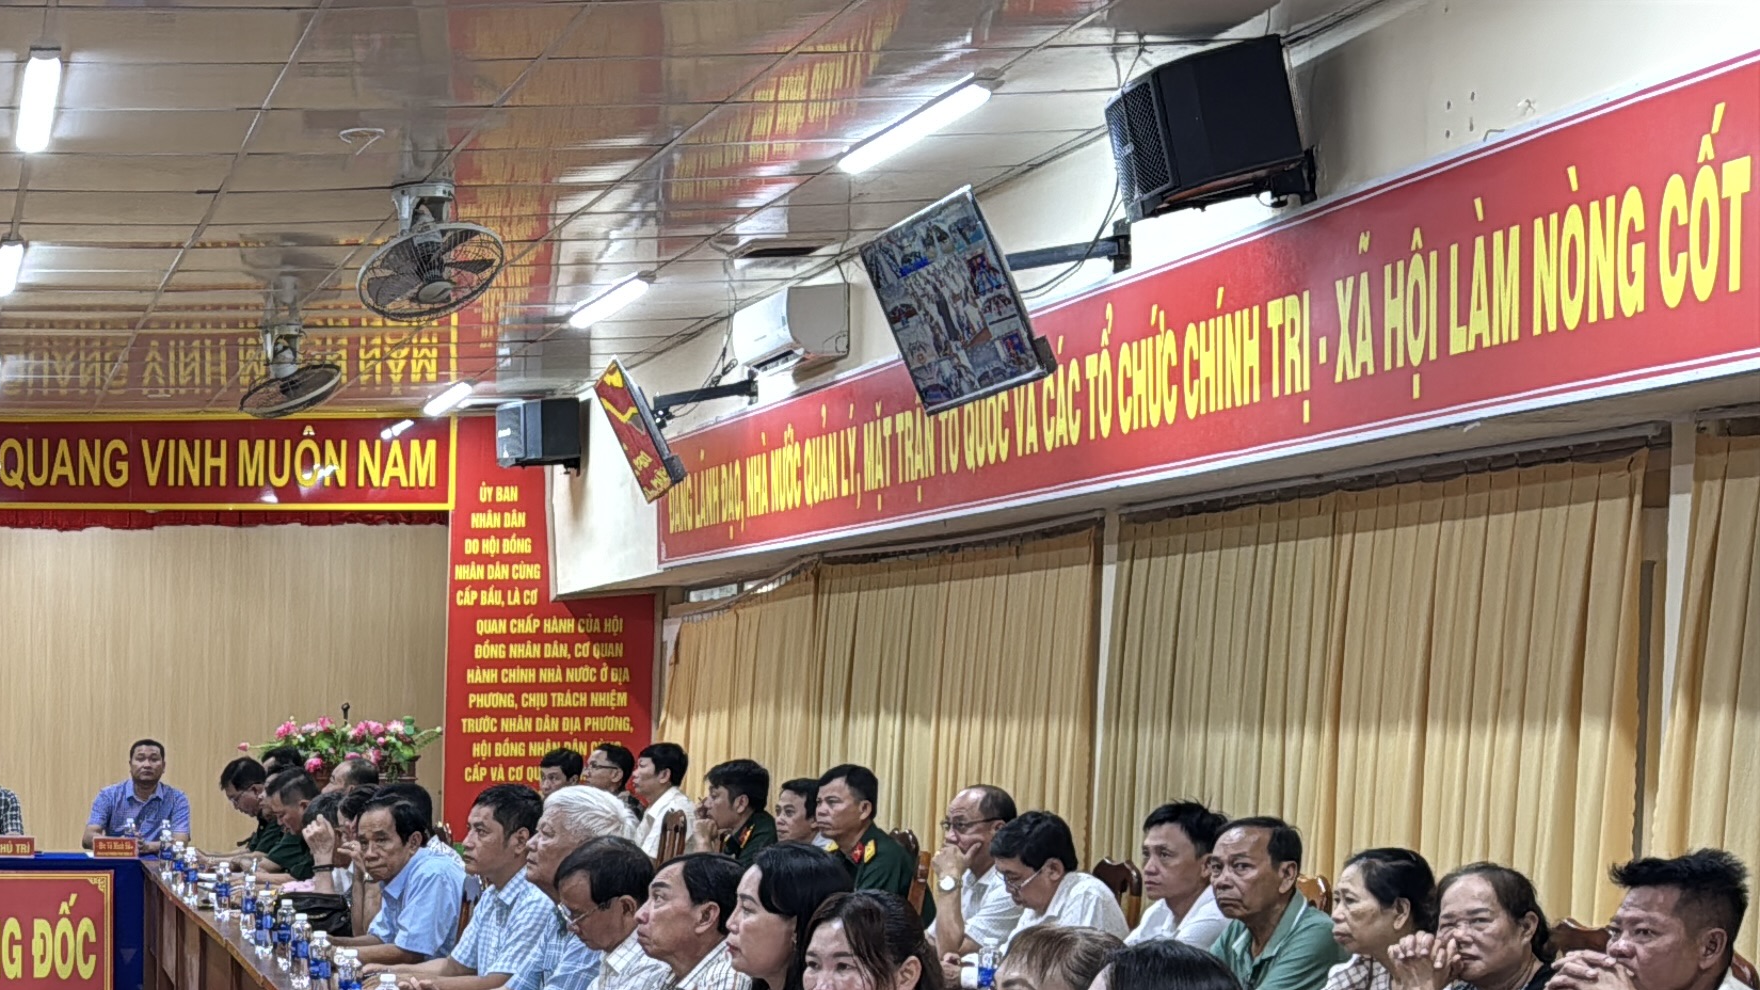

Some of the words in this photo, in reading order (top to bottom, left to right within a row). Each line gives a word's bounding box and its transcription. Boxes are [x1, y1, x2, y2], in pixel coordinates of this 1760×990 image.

[695, 449, 720, 529] LÃNH
[721, 458, 744, 540] ĐẠO,
[746, 432, 768, 518] NHÀ
[771, 423, 802, 512] NƯỚC
[804, 404, 838, 509] QUẢN
[841, 403, 861, 510] LÝ,
[864, 400, 893, 512] MẶT
[1042, 335, 1082, 452] CÁC
[1086, 302, 1112, 440] TỔ
[1118, 304, 1178, 435] CHỨC
[1184, 286, 1260, 421] CHÍNH
[1267, 290, 1310, 424] TRỊ
[1319, 336, 1327, 364] -
[1334, 230, 1374, 383] XÃ
[1384, 226, 1438, 400] HỘI
[1449, 196, 1520, 356] LÀM
[1533, 165, 1645, 337] NÒNG
[1658, 102, 1752, 309] CỐT
[142, 438, 227, 487] VINH
[238, 424, 347, 488] MUÔN
[480, 481, 493, 502] ỦY
[496, 486, 518, 502] BAN
[471, 509, 500, 528] NHÂN
[504, 509, 525, 527] DÂN
[465, 539, 478, 554] DO
[482, 536, 499, 557] HỘI
[503, 533, 531, 554] ĐỒNG
[455, 561, 484, 580] NHÂN
[487, 561, 509, 579] DÂN
[512, 561, 540, 579] CÙNG
[456, 585, 477, 606] CẤP
[480, 585, 505, 607] BẦU,
[508, 586, 520, 605] LÀ
[523, 589, 538, 604] CƠ
[476, 619, 506, 635] QUAN
[510, 614, 540, 634] CHẤP
[544, 615, 574, 633] HÀNH
[578, 613, 600, 632] CỦA
[604, 615, 623, 635] HỘI
[475, 639, 506, 659] ĐỒNG
[509, 641, 540, 658] NHÂN
[544, 640, 571, 659] DÂN,
[575, 642, 590, 658] CƠ
[593, 643, 623, 659] QUAN
[467, 666, 497, 684] HÀNH
[501, 666, 536, 683] CHÍNH
[539, 665, 562, 683] NHÀ
[566, 666, 596, 682] NƯỚC
[600, 663, 608, 682] Ở
[611, 667, 630, 685] ĐỊA
[468, 693, 518, 709] PHƯƠNG,
[521, 693, 548, 710] CHỊU
[551, 690, 587, 707] TRÁCH
[591, 689, 627, 709] NHIỆM
[461, 716, 497, 733] TRƯỚC
[501, 715, 532, 732] NHÂN
[536, 715, 559, 732] DÂN
[562, 717, 580, 734] ĐỊA
[584, 717, 634, 733] PHƯƠNG,
[473, 740, 491, 761] HỘI
[495, 738, 525, 757] ĐỒNG
[465, 762, 487, 782] CẤP
[491, 764, 505, 781] VÀ
[509, 766, 524, 781] CƠ
[31, 893, 97, 980] ĐỐC
